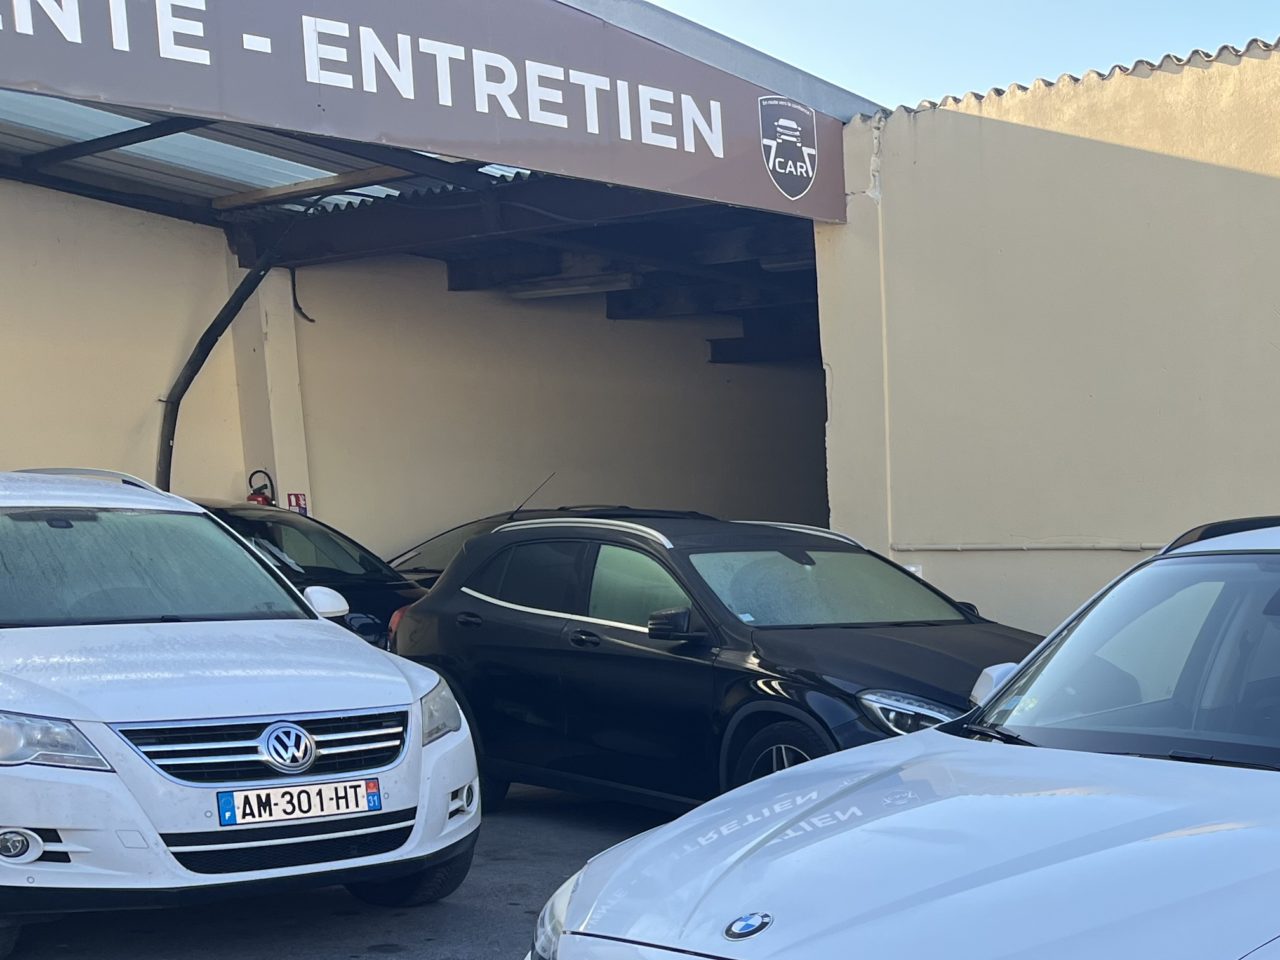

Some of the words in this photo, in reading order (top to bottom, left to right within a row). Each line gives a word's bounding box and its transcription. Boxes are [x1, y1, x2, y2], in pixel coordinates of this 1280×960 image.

[302, 15, 724, 158] ENTRETIEN
[241, 784, 361, 819] AM-301-HT
[368, 795, 379, 806] 31
